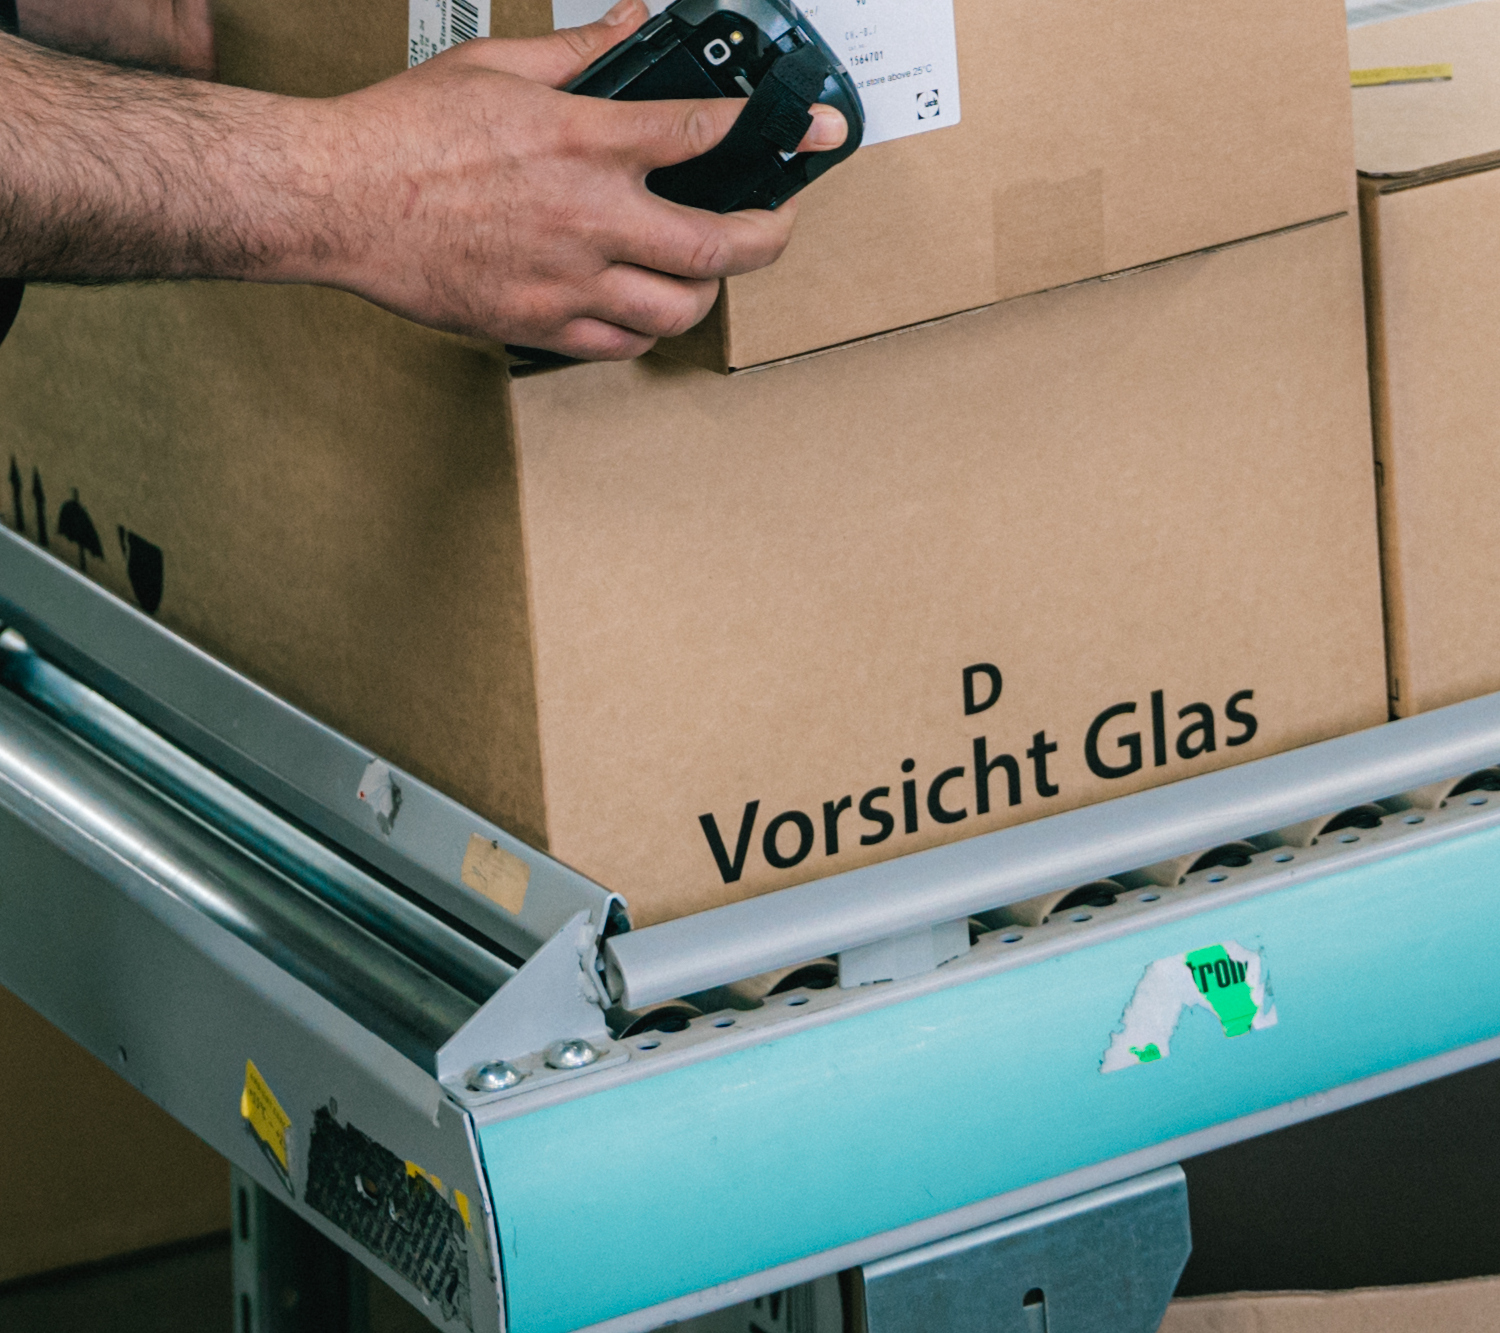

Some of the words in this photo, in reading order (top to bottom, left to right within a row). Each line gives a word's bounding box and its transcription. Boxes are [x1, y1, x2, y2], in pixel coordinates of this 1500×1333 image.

[866, 77, 885, 86] store
[887, 70, 911, 81] above
[962, 662, 1003, 716] D
[698, 730, 1059, 885] Vorsicht
[1084, 689, 1258, 780] Glas
